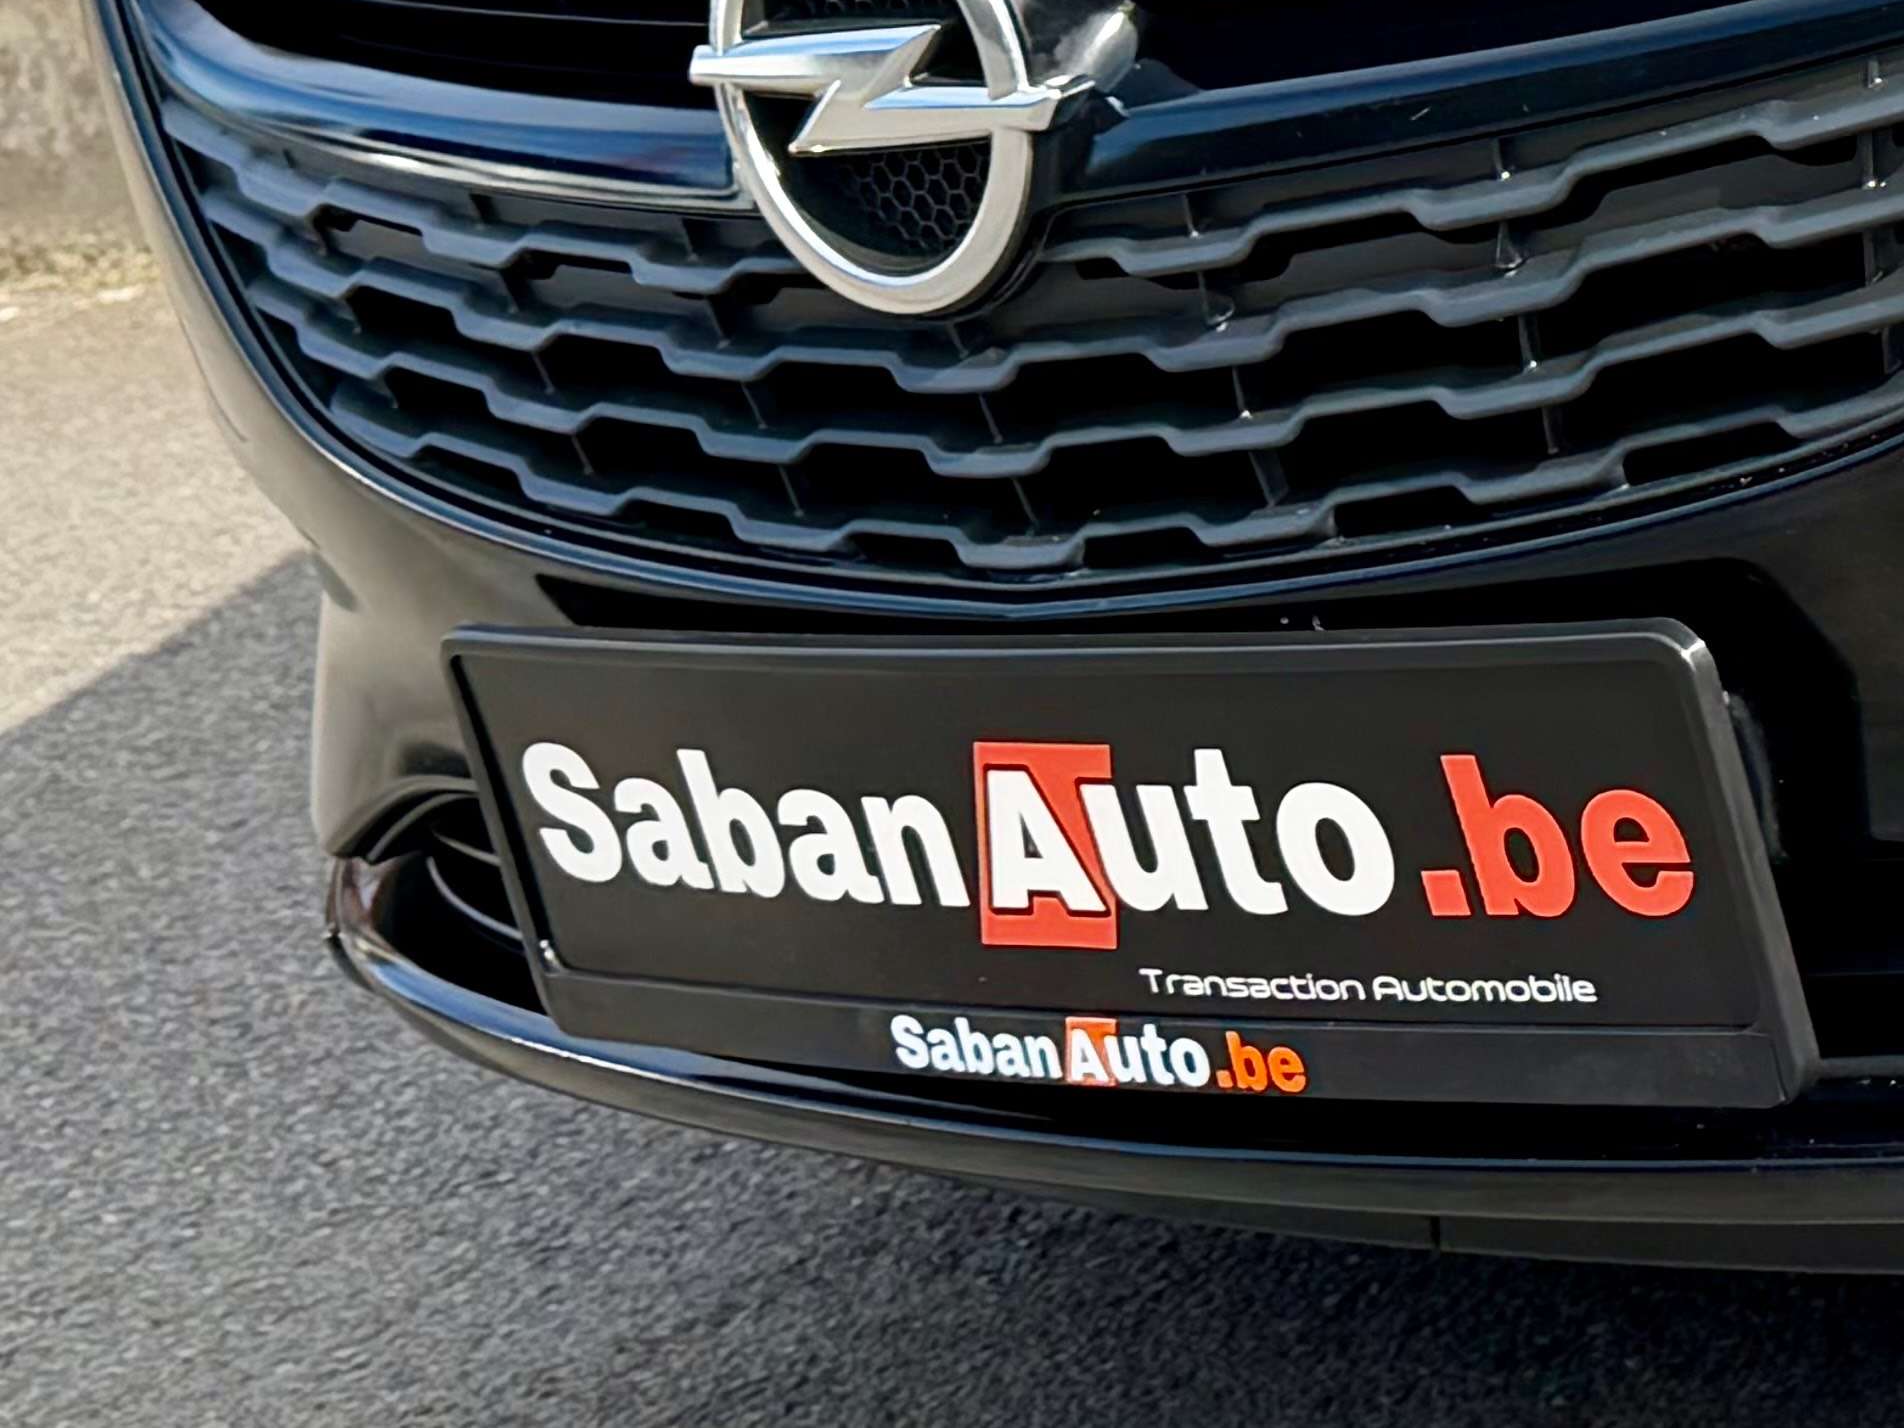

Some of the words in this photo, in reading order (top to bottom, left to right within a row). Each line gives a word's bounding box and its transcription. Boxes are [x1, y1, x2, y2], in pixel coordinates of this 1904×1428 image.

[521, 741, 1697, 919] SabanAuto.be
[1138, 967, 1367, 1002] Transaction
[1371, 973, 1599, 1004] Automobile
[889, 1014, 1308, 1095] SabanAuto.be
